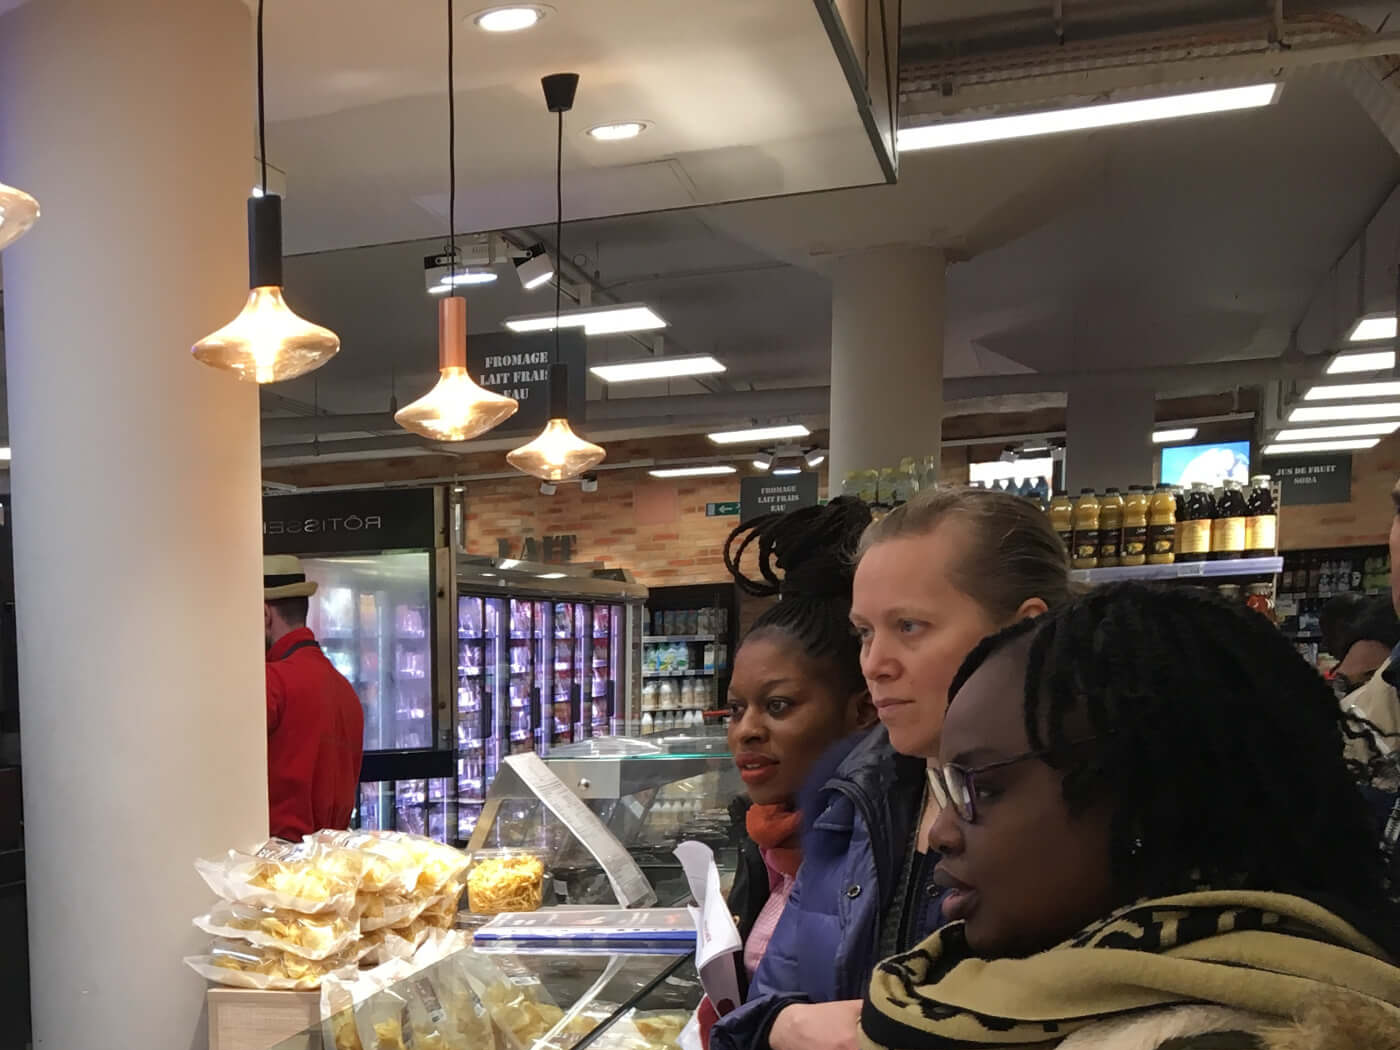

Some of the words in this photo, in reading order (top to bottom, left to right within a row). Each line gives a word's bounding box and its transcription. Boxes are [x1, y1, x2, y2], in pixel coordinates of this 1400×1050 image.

[485, 351, 548, 368] FROMAGE
[480, 372, 510, 386] LAIT
[1294, 466, 1307, 474] DE
[1307, 465, 1337, 474] FRUIT
[760, 484, 797, 495] FROMAGE
[757, 496, 775, 504] LAIT
